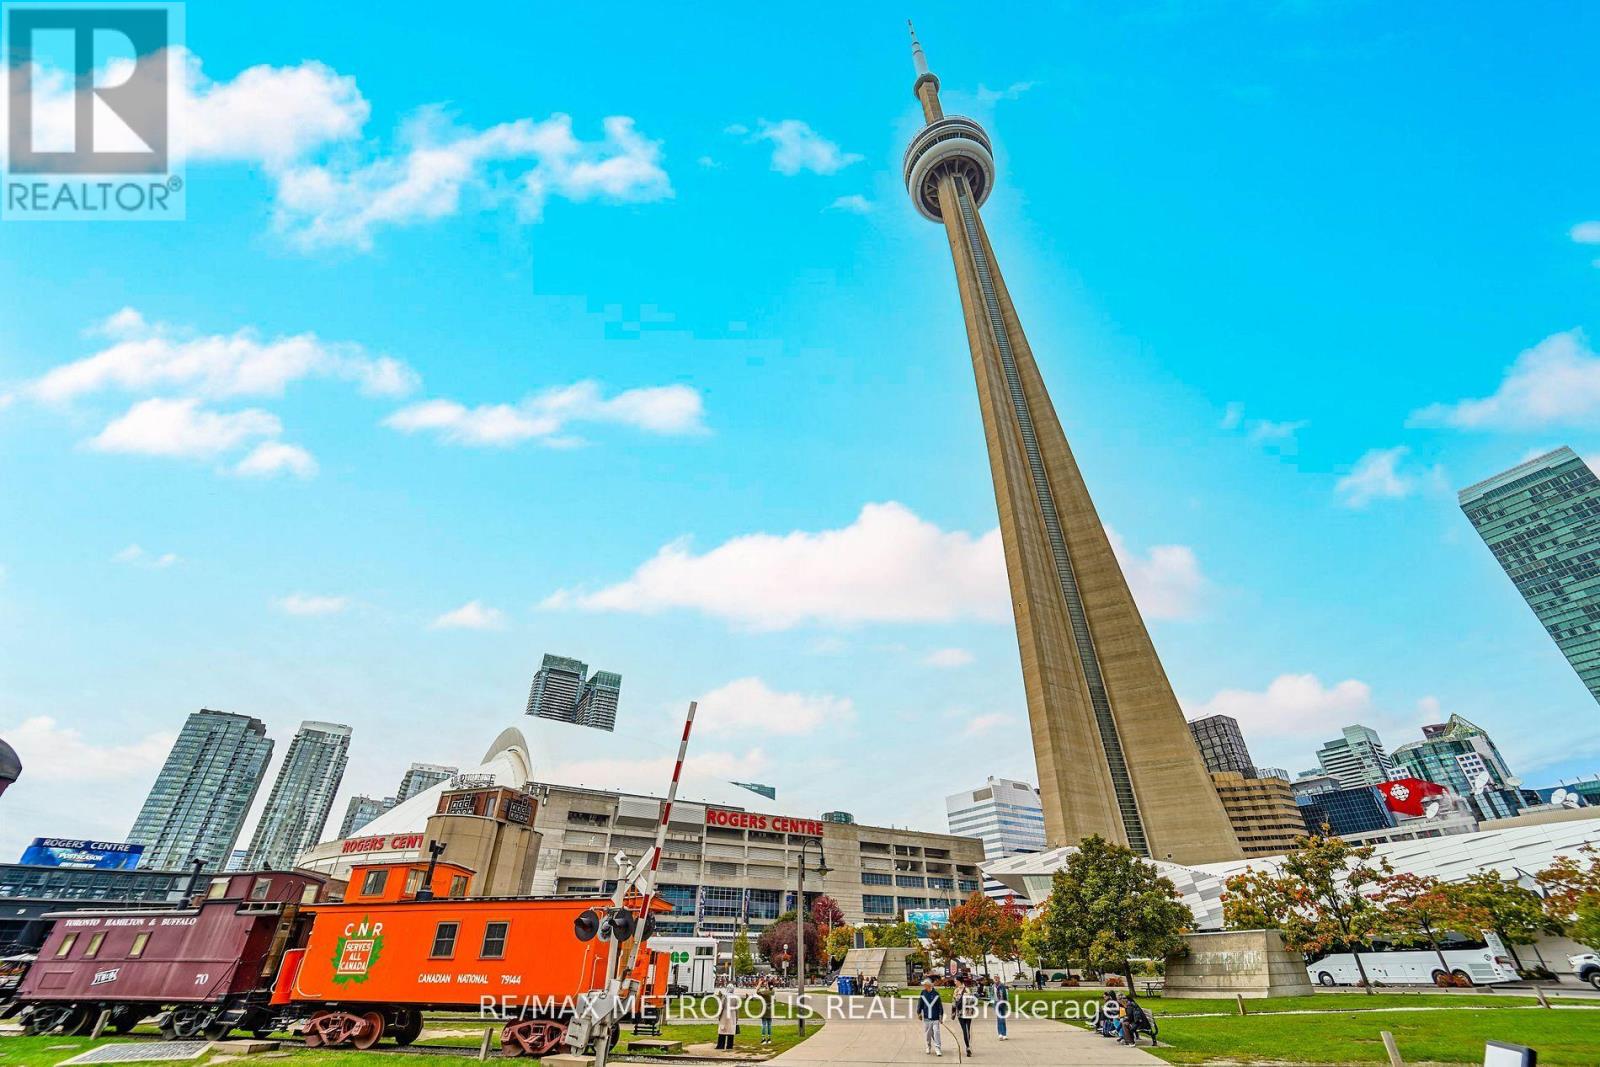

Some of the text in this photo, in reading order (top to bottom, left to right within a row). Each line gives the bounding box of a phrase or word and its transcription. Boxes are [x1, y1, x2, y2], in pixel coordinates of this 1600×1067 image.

[705, 808, 824, 836] ROGERS CENTRE
[43, 839, 131, 852] ROGERS CENTRE
[342, 837, 386, 853] ROGERS
[65, 918, 101, 927] TORONTO
[104, 918, 144, 927] HAMILTON
[161, 917, 197, 926] BUFFALO
[346, 943, 371, 951] SERVES
[349, 952, 361, 961] ALL
[341, 961, 366, 971] CANADA
[195, 973, 209, 985] 70
[418, 974, 452, 984] CANADIAN
[457, 974, 488, 984] NATIONAL
